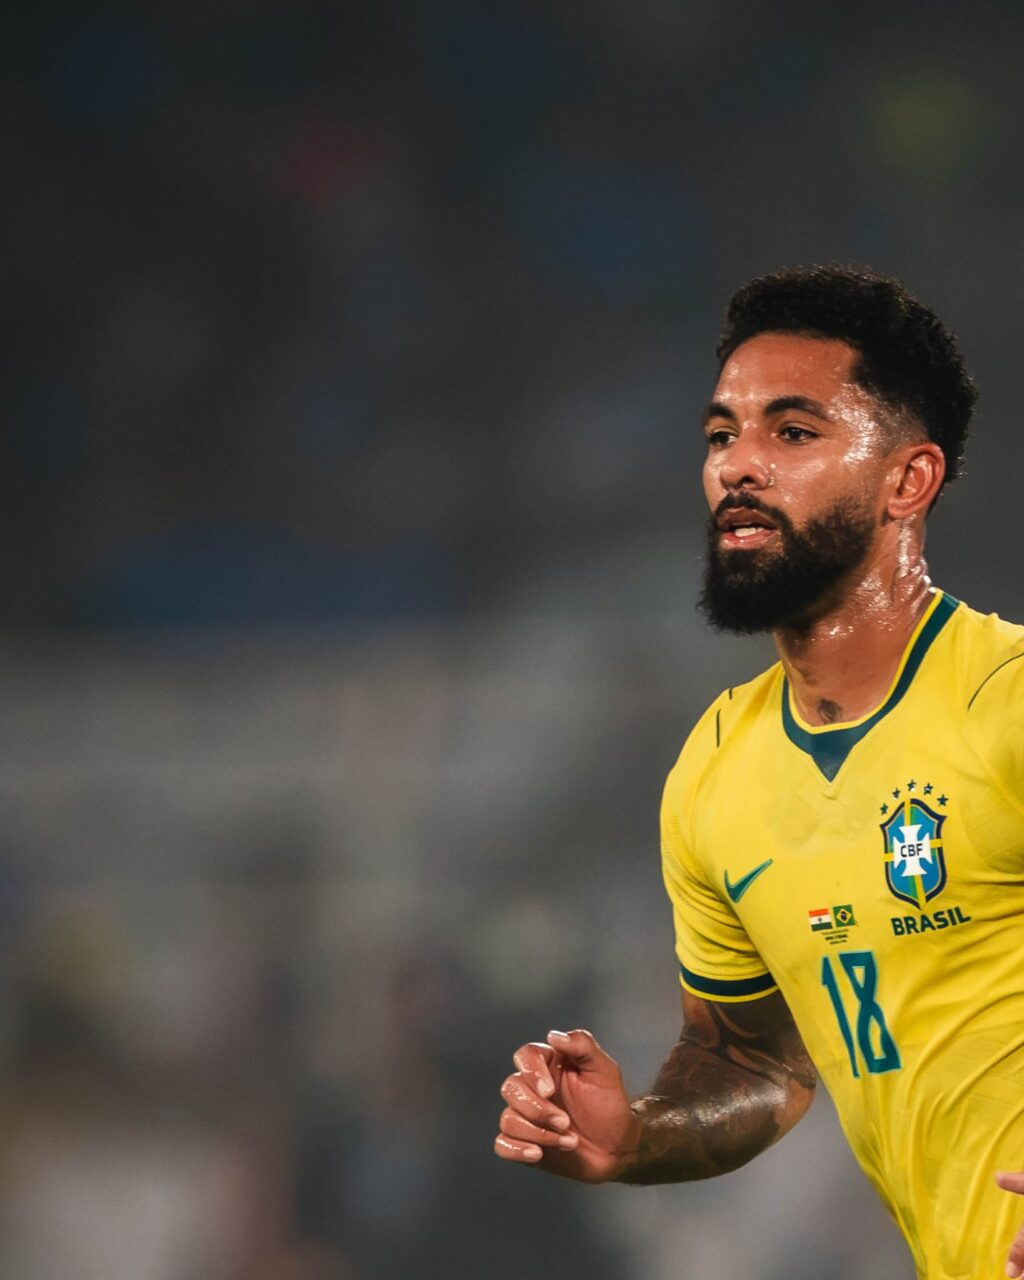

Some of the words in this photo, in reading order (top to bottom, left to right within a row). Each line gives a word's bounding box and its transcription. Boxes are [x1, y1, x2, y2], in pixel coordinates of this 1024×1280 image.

[900, 843, 924, 858] CBF
[890, 905, 972, 936] BRASIL
[820, 950, 902, 1079] 18
